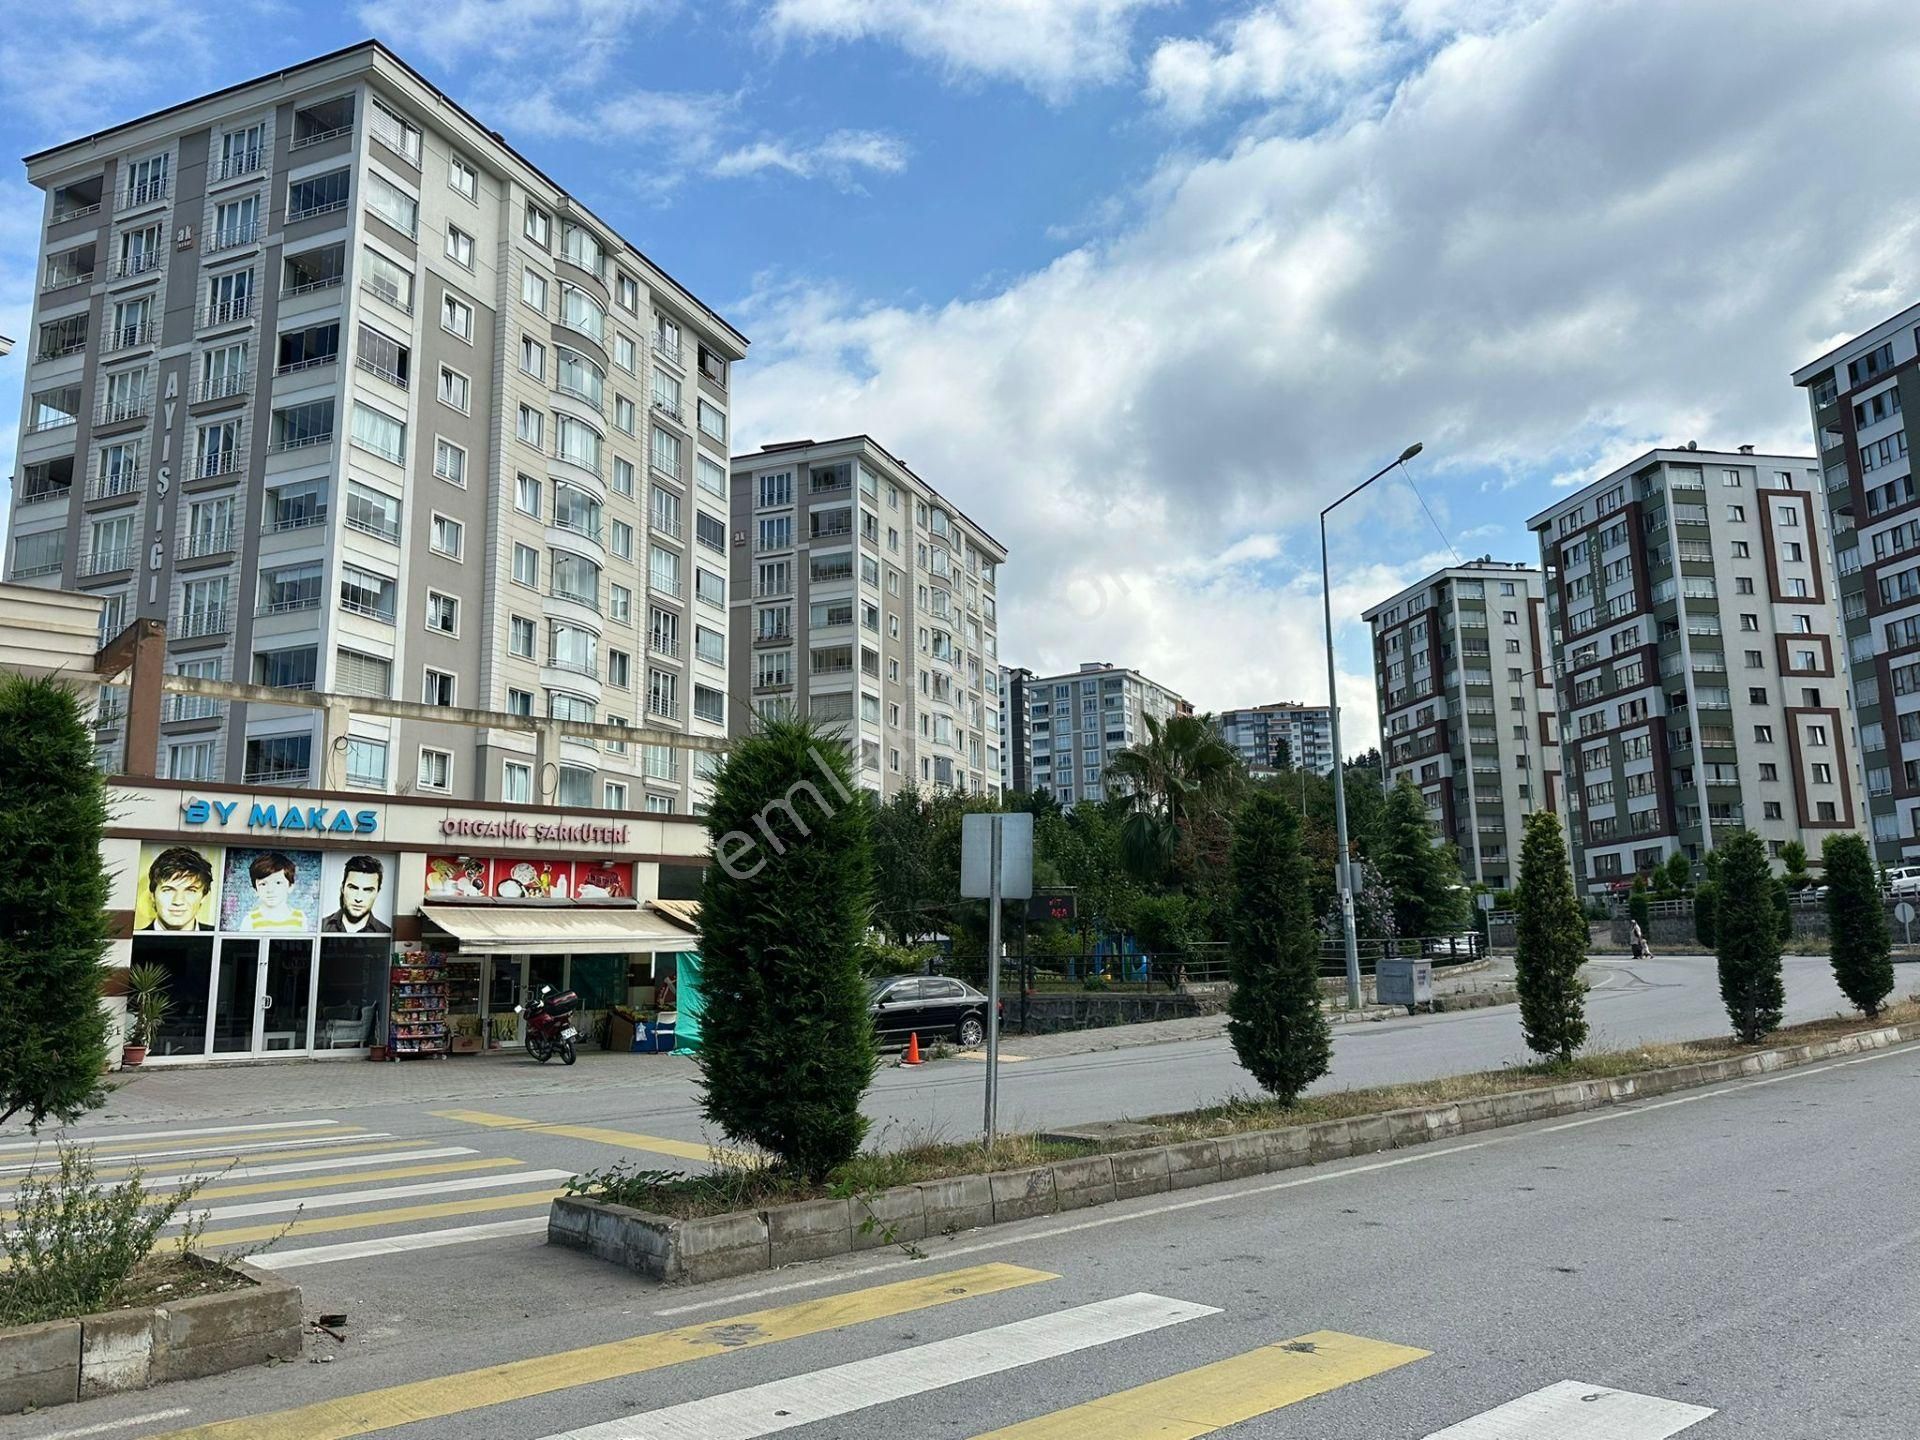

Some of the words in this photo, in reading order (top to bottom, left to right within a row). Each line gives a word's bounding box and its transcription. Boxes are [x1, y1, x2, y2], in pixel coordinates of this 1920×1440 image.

[149, 371, 178, 604] AYIŞIĞI
[185, 800, 238, 826] BY
[248, 803, 378, 834] MAKAS
[442, 818, 529, 839] ORGANİK
[535, 822, 630, 844] ŞARKÜTERİ
